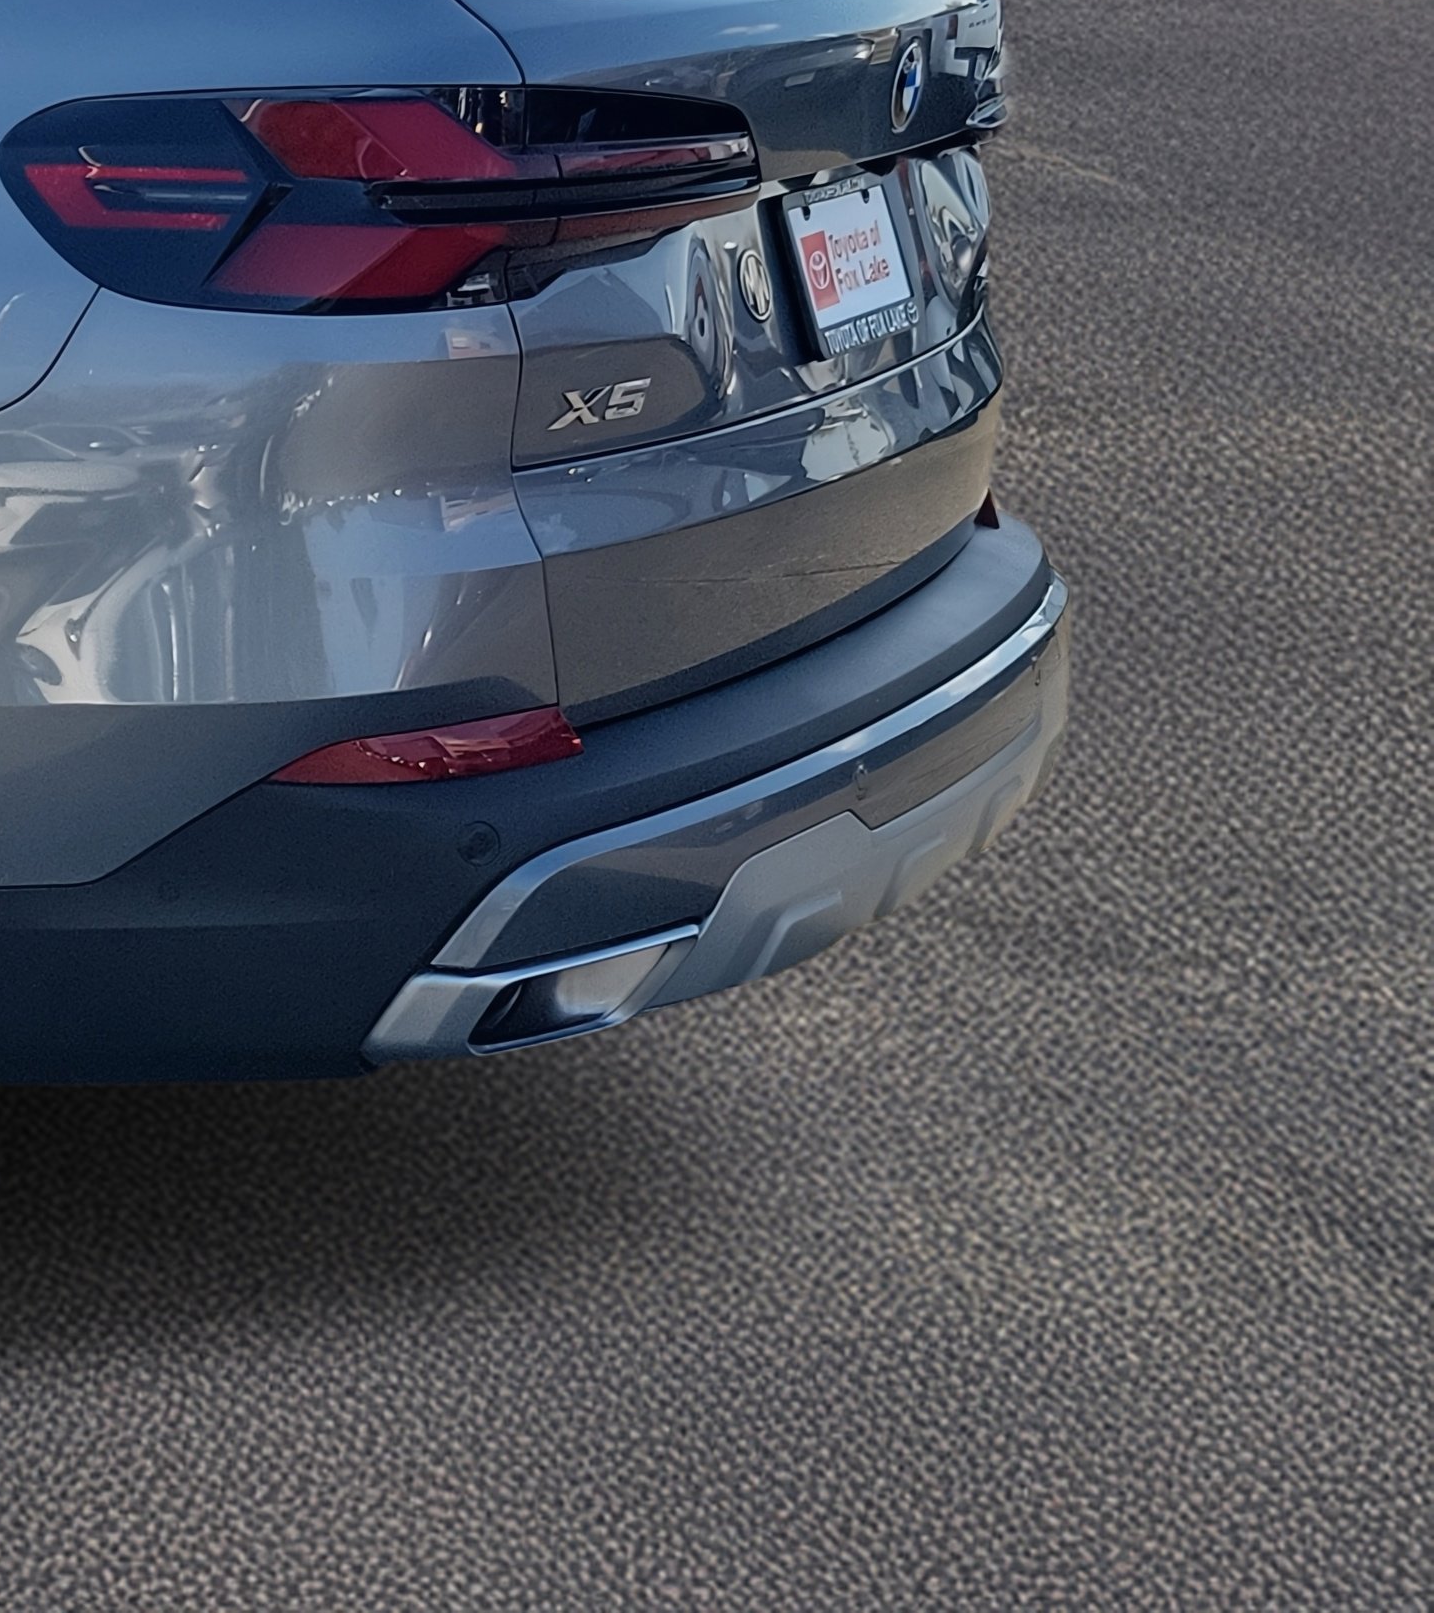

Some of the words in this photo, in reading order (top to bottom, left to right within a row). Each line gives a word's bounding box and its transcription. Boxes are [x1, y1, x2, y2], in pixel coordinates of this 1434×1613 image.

[828, 228, 870, 262] Toyota
[835, 268, 861, 295] Fox
[859, 255, 890, 285] Lake
[546, 377, 652, 431] X5
